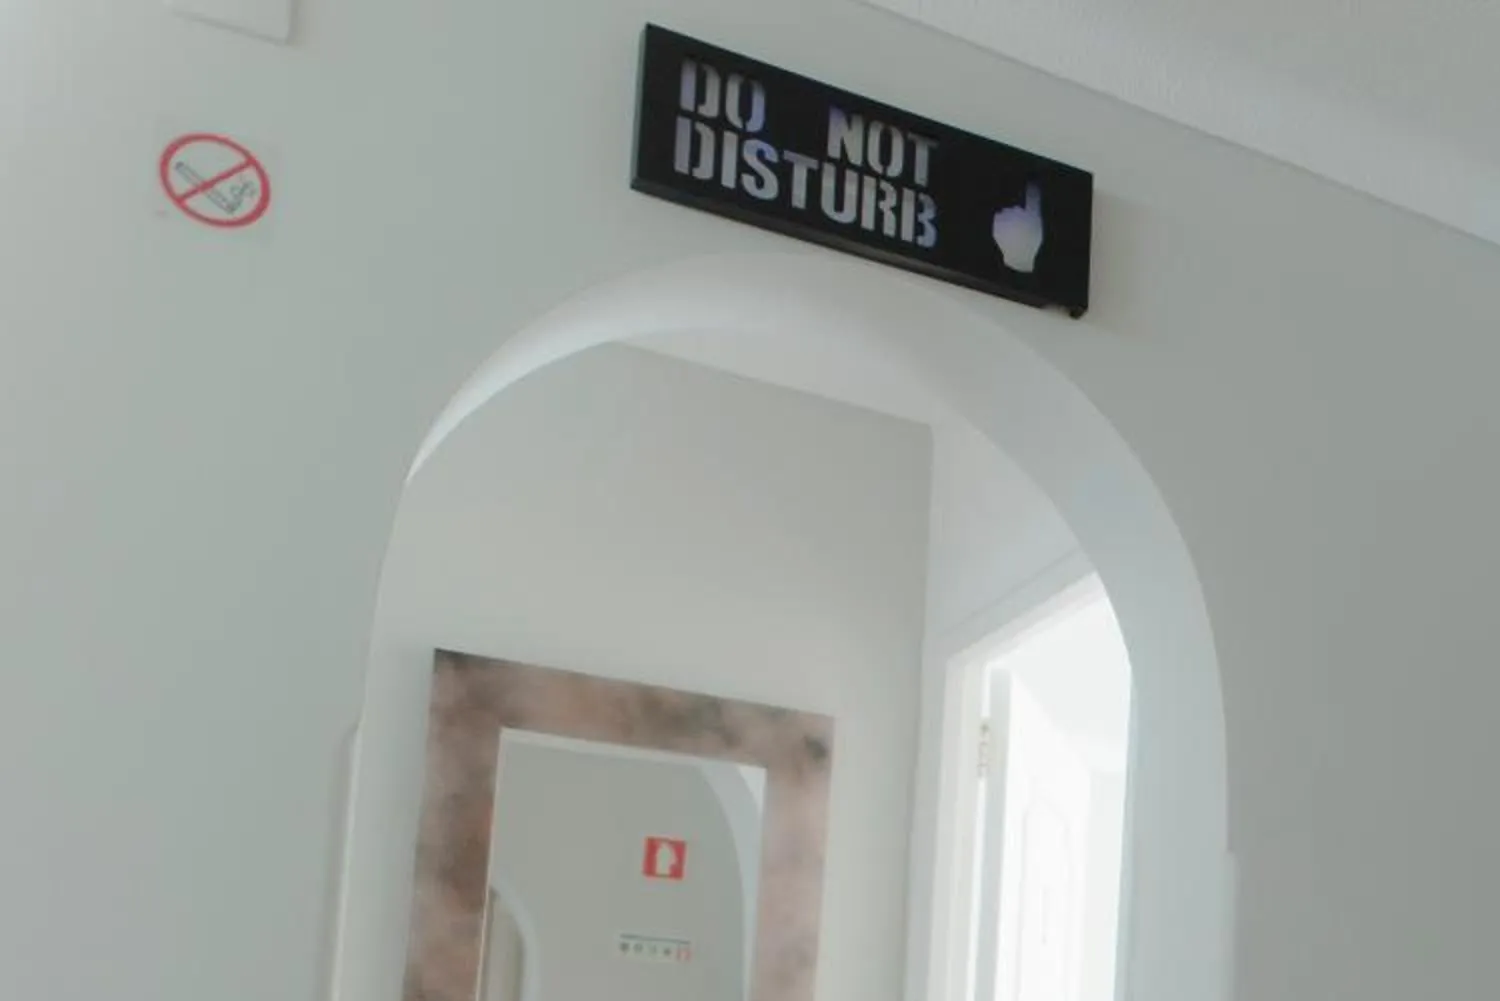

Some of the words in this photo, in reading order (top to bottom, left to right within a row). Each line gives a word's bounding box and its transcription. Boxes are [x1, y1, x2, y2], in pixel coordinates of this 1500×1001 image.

[674, 117, 938, 248] DISTURB
[680, 60, 765, 133] DO
[827, 105, 938, 186] NOT
